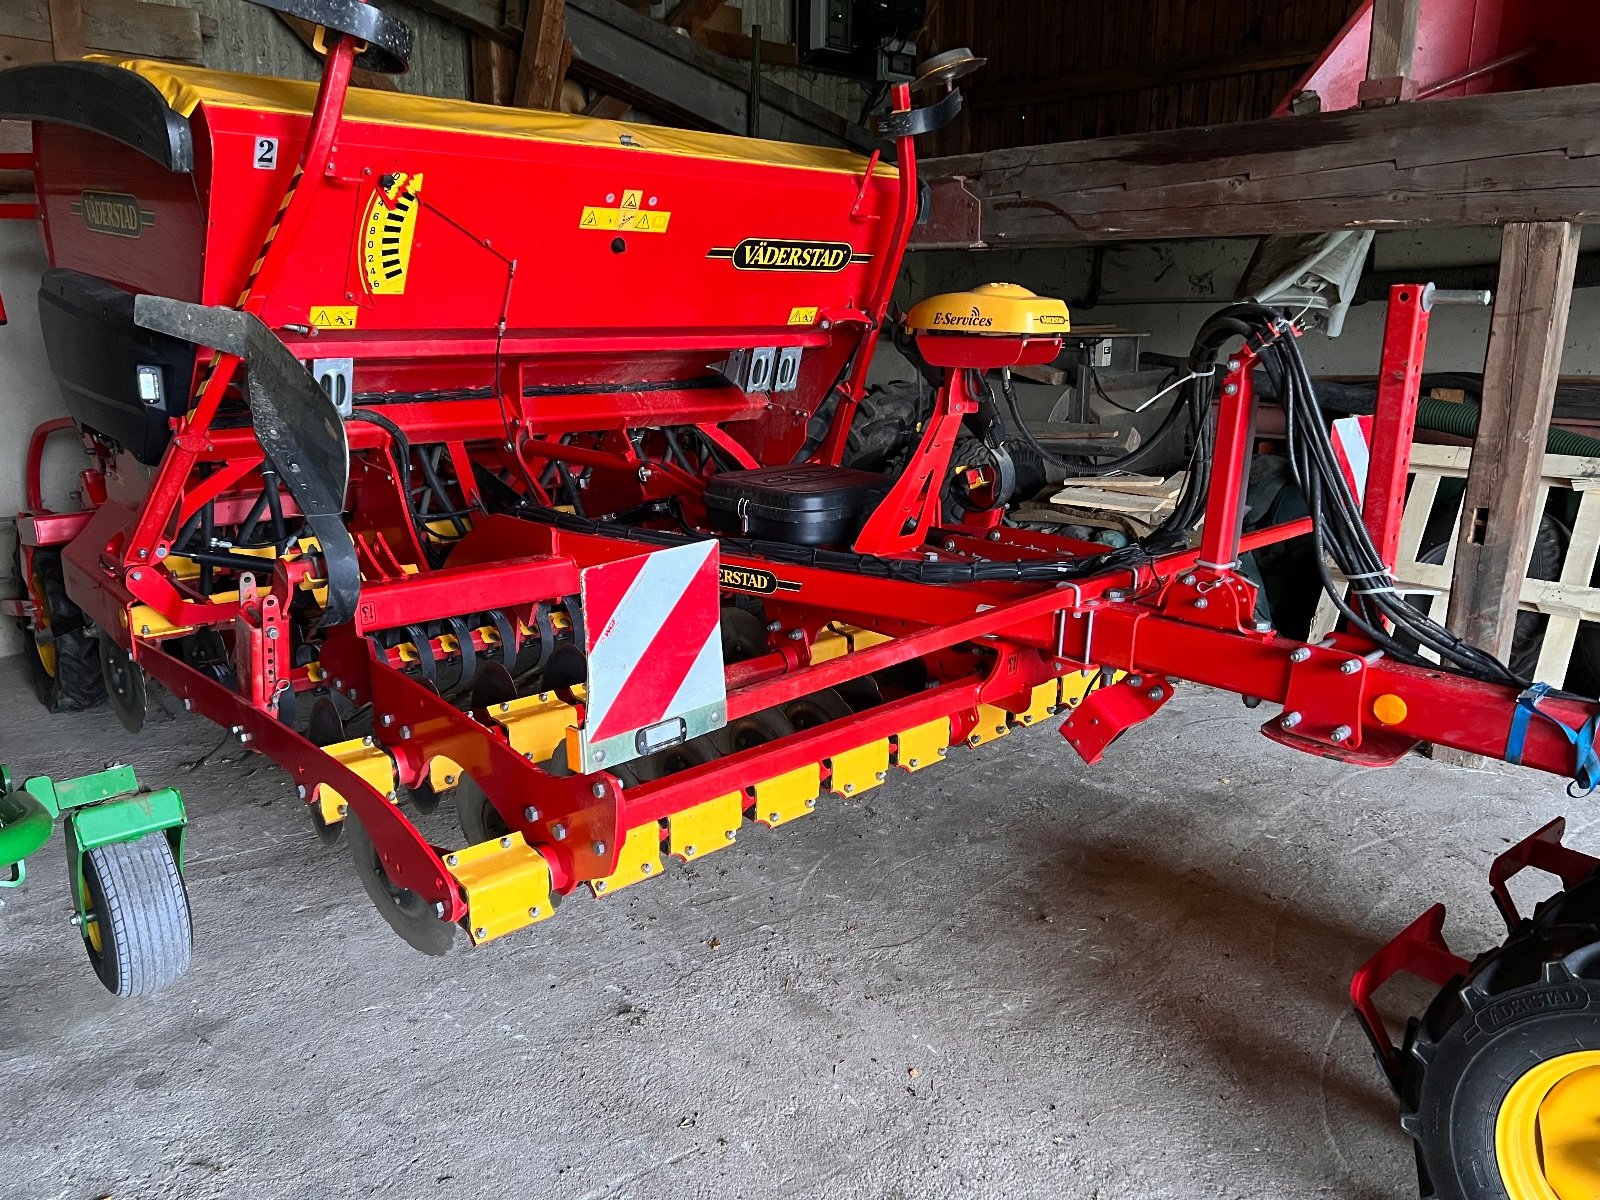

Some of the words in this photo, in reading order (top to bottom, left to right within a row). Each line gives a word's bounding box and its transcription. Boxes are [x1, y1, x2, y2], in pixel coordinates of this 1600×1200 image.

[257, 139, 274, 164] 2
[84, 195, 138, 231] VÄDERSTAD
[373, 212, 380, 221] 6
[370, 226, 376, 235] 8
[744, 241, 845, 268] VÄDERSTAD
[933, 312, 993, 327] E-Services
[718, 568, 768, 589] ERSTAD
